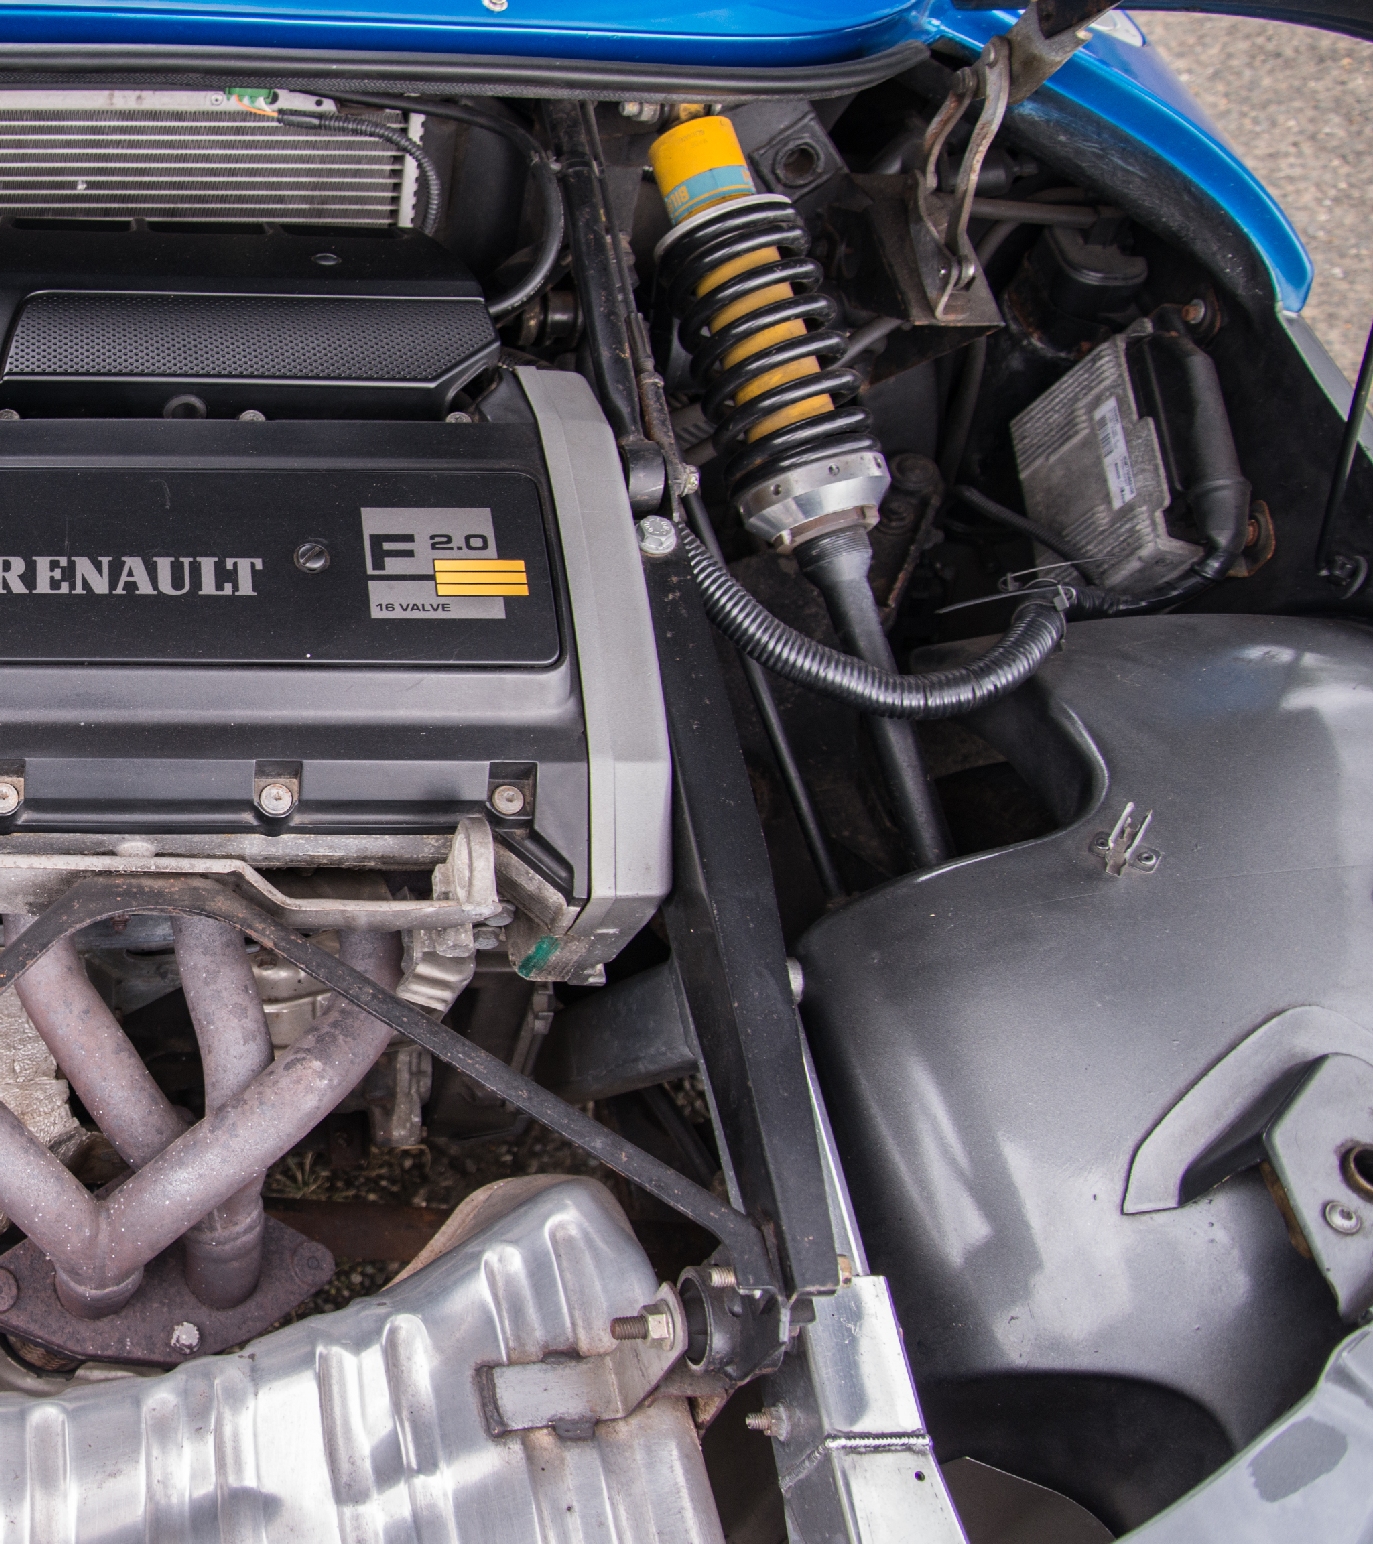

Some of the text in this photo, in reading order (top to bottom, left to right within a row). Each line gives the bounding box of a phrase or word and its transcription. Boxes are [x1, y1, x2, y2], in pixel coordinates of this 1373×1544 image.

[369, 534, 489, 571] F 2.0
[376, 603, 452, 612] 16 VALVE
